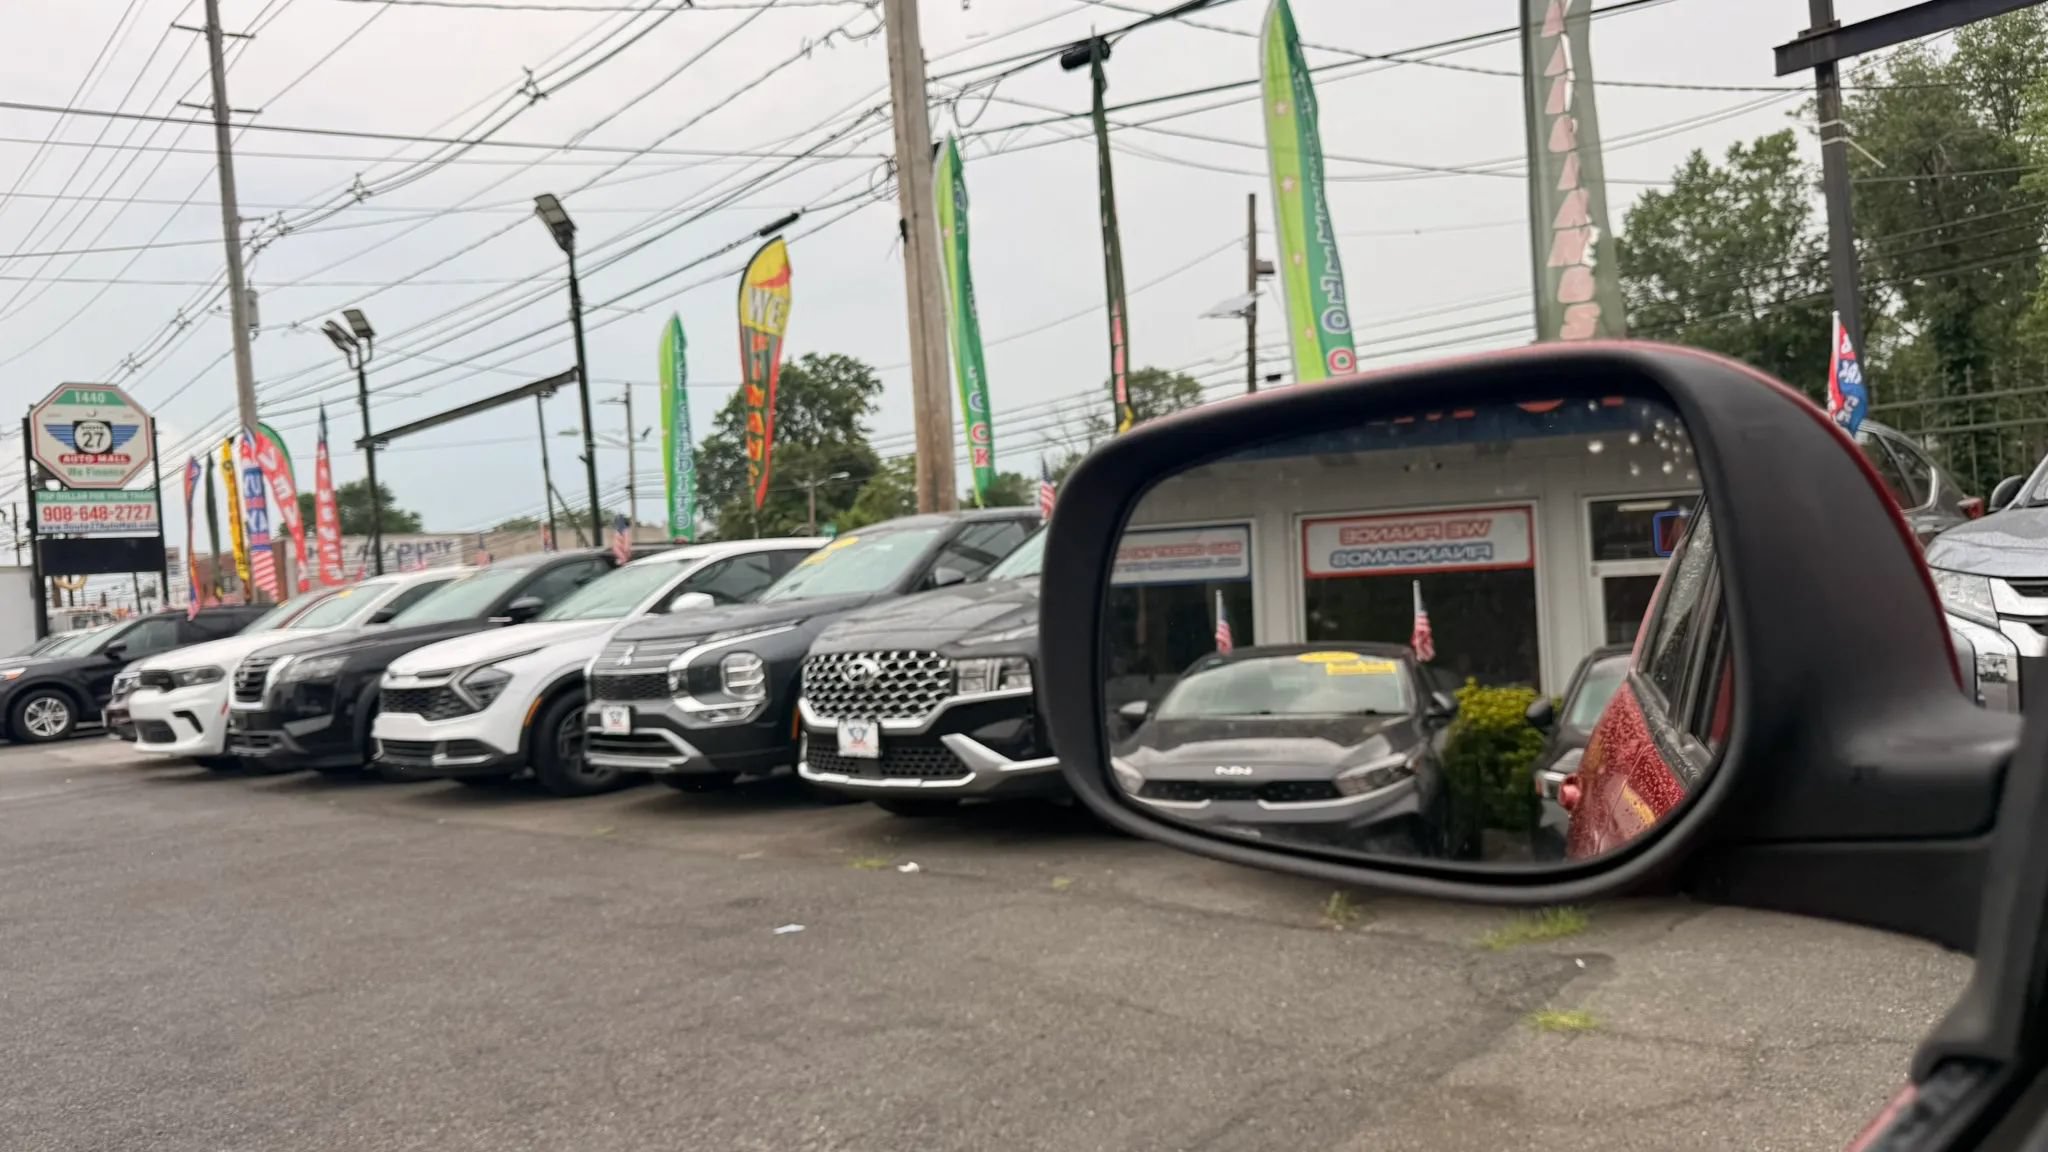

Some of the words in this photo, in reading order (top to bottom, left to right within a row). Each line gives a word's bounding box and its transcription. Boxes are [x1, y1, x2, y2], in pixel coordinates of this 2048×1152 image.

[750, 286, 785, 330] WE
[75, 391, 106, 404] 1440
[82, 432, 105, 448] 27
[62, 454, 94, 463] AUTO
[97, 454, 128, 463] MALL
[43, 505, 152, 522] 908-648-2727
